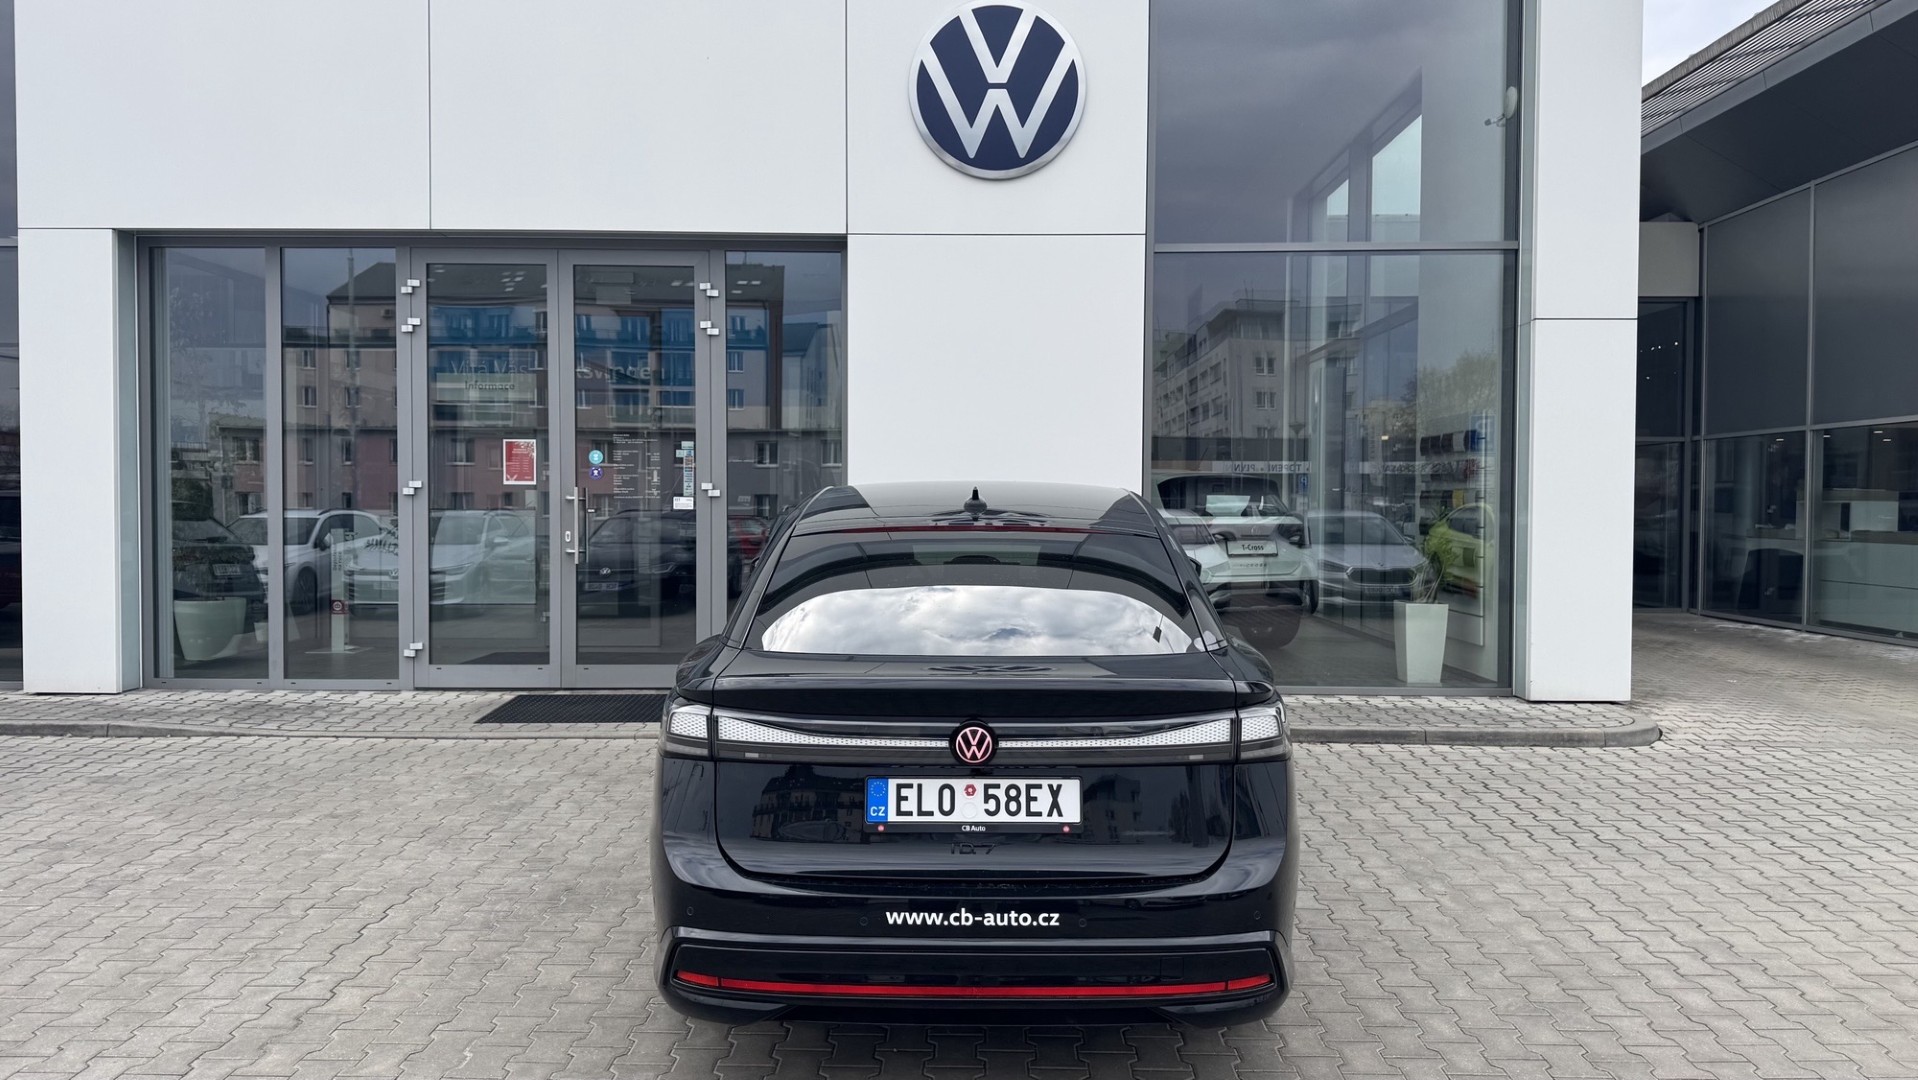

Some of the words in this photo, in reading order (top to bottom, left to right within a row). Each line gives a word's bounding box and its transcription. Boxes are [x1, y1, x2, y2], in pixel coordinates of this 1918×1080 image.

[464, 380, 516, 391] Informace
[1241, 543, 1265, 552] T-Cross
[983, 783, 1064, 817] 58EX
[870, 806, 886, 817] CZ
[885, 908, 1060, 927] www.cb-auto.cz
